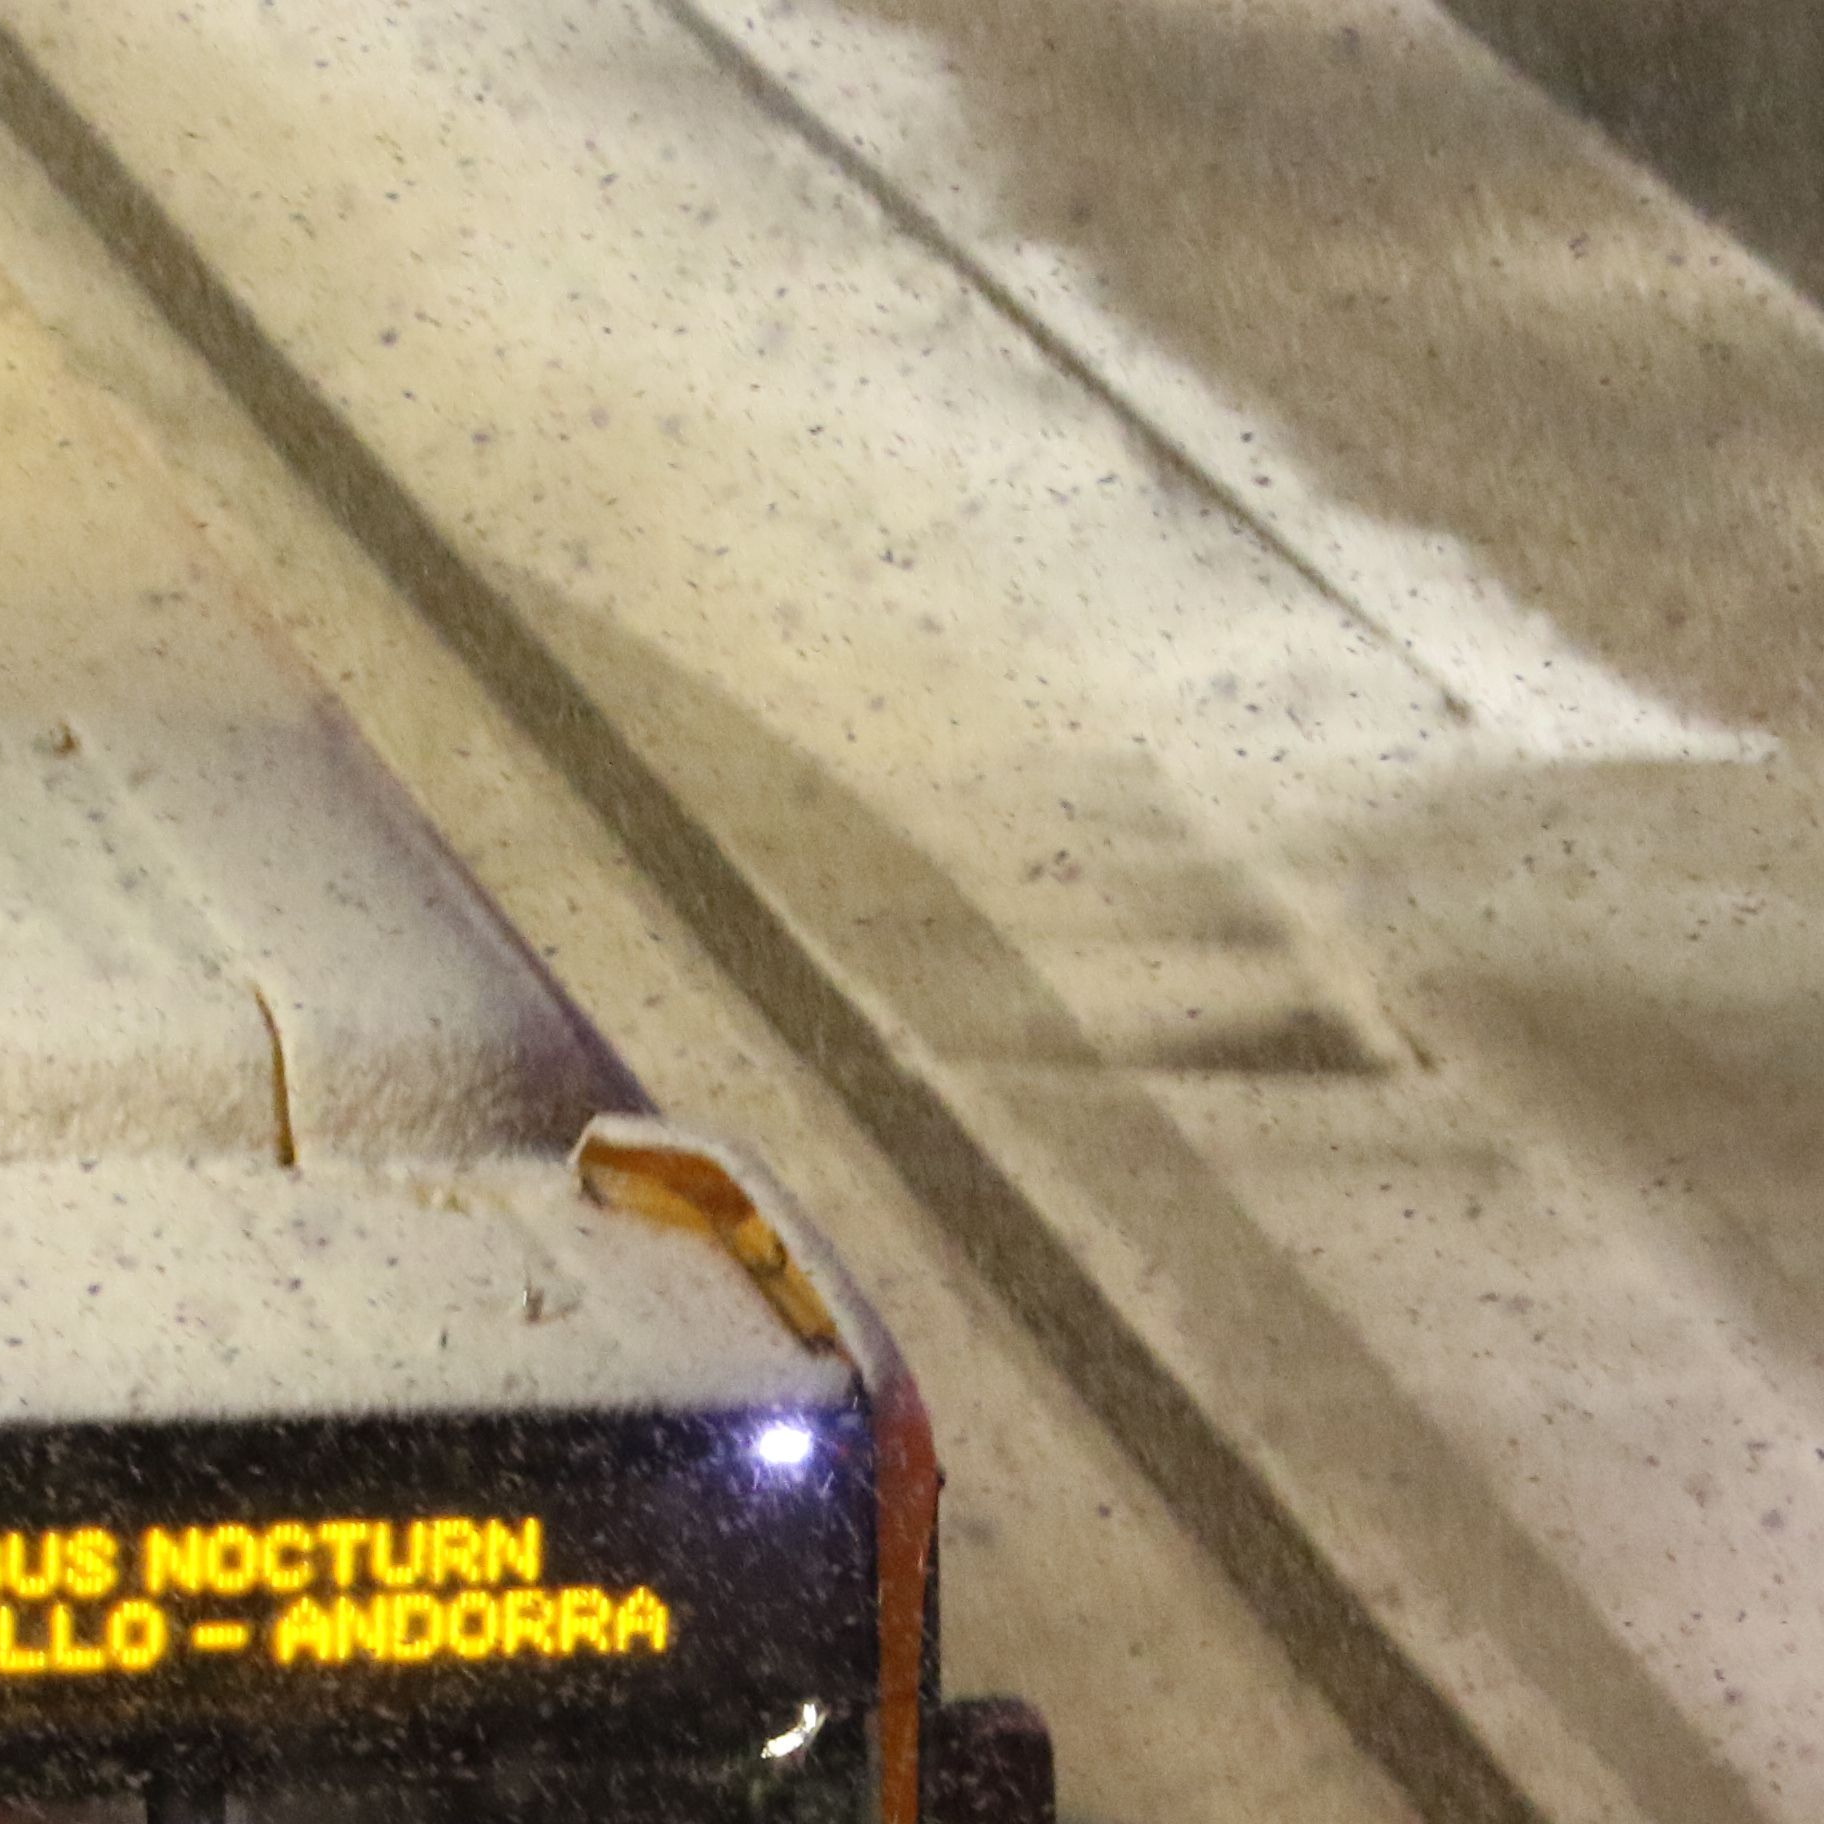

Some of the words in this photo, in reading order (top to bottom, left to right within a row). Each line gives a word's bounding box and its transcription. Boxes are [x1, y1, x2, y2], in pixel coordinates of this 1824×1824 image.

[144, 1517, 540, 1596] NOCTURN
[191, 1620, 249, 1651] -
[276, 1585, 670, 1664] ANDORRA
